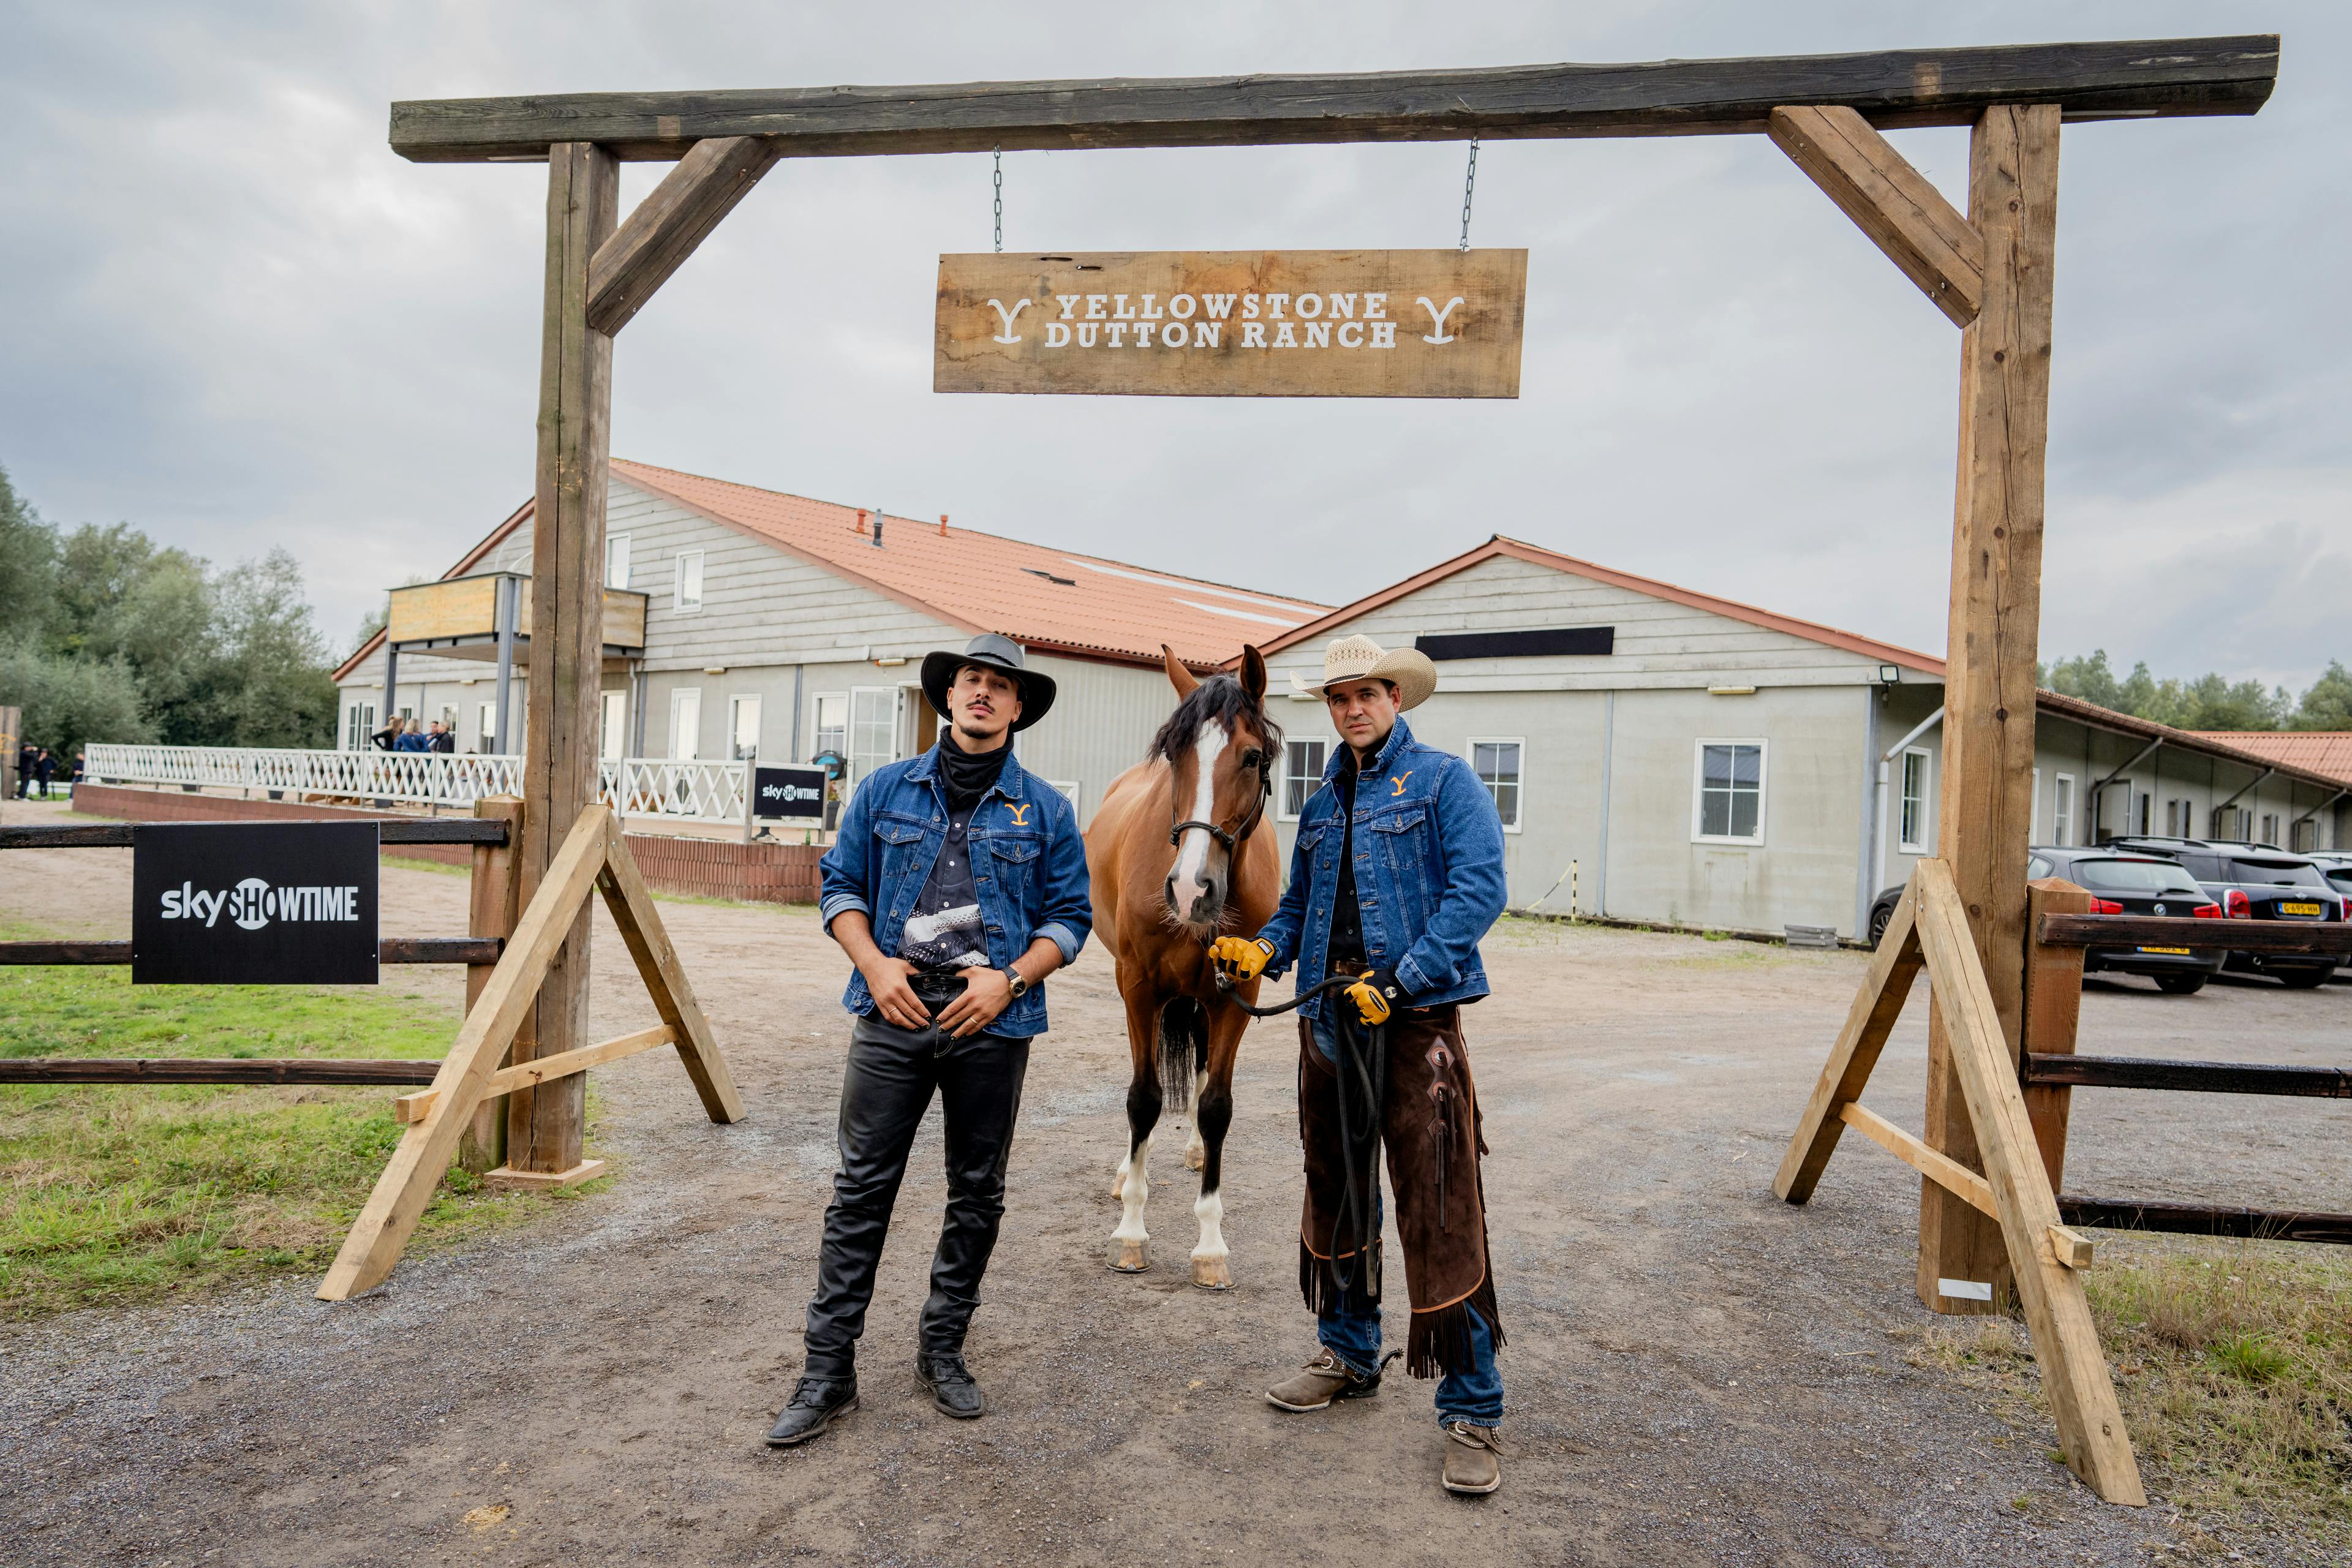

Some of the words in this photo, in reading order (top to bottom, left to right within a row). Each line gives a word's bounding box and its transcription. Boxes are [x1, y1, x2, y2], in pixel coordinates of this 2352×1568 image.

[1056, 293, 1387, 320] YELLOWSTONE
[1044, 322, 1223, 348] DUTTON
[1241, 322, 1397, 349] RANCH
